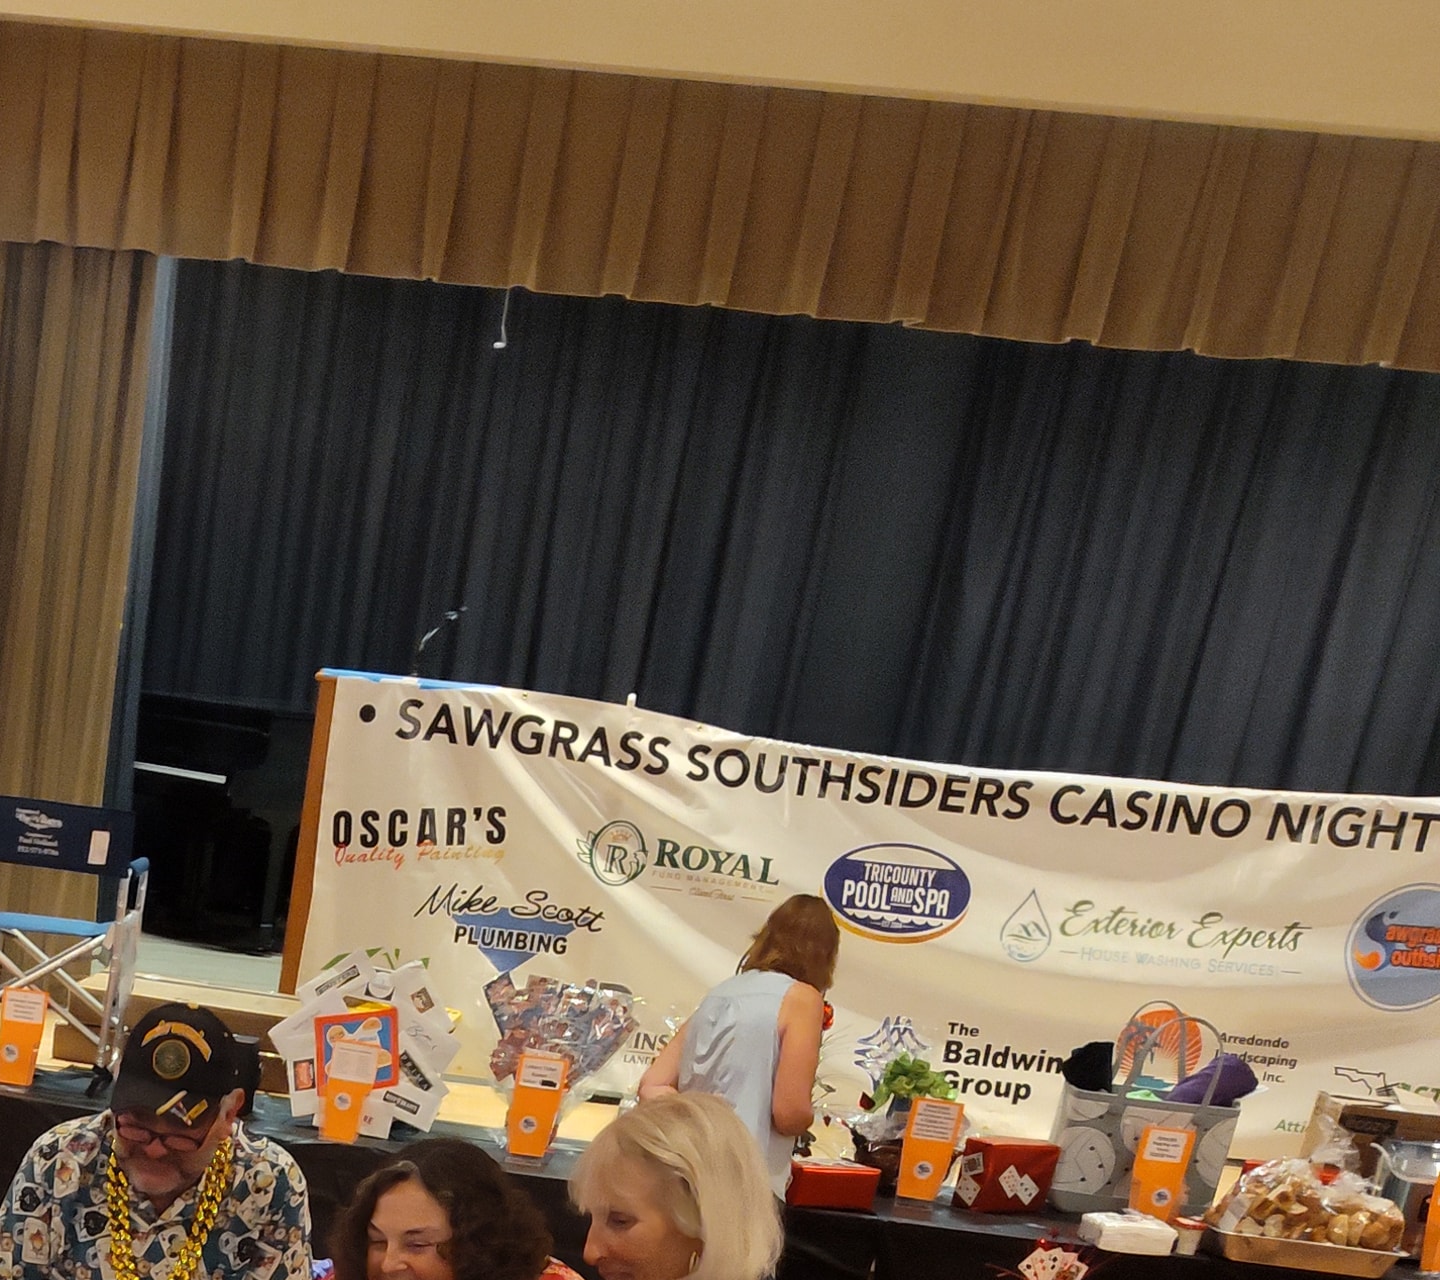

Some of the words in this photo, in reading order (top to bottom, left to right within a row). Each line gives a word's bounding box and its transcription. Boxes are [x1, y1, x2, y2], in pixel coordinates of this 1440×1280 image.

[395, 698, 671, 776] SAWGRASS
[685, 743, 1033, 820] SOUTHSIDERS
[1049, 784, 1251, 839] CASINO
[1266, 802, 1440, 853] NIGHT
[333, 806, 507, 849] OSCAR'S
[334, 843, 405, 870] Quality
[653, 838, 780, 886] ROYAL
[864, 863, 937, 888] TRICOUNTY
[413, 882, 501, 919] Mike
[510, 890, 606, 933] Scott
[842, 879, 891, 910] POOL
[891, 887, 914, 904] AND
[912, 886, 950, 917] SPA
[453, 924, 568, 956] PLUMBING
[1059, 899, 1181, 940] Exterior
[1187, 911, 1313, 959] Experts
[948, 1022, 980, 1038] The
[1219, 1032, 1290, 1049] Arredondo
[942, 1040, 1063, 1075] Baldwin
[1215, 1049, 1298, 1070] Ldscaping
[944, 1070, 1032, 1105] Group
